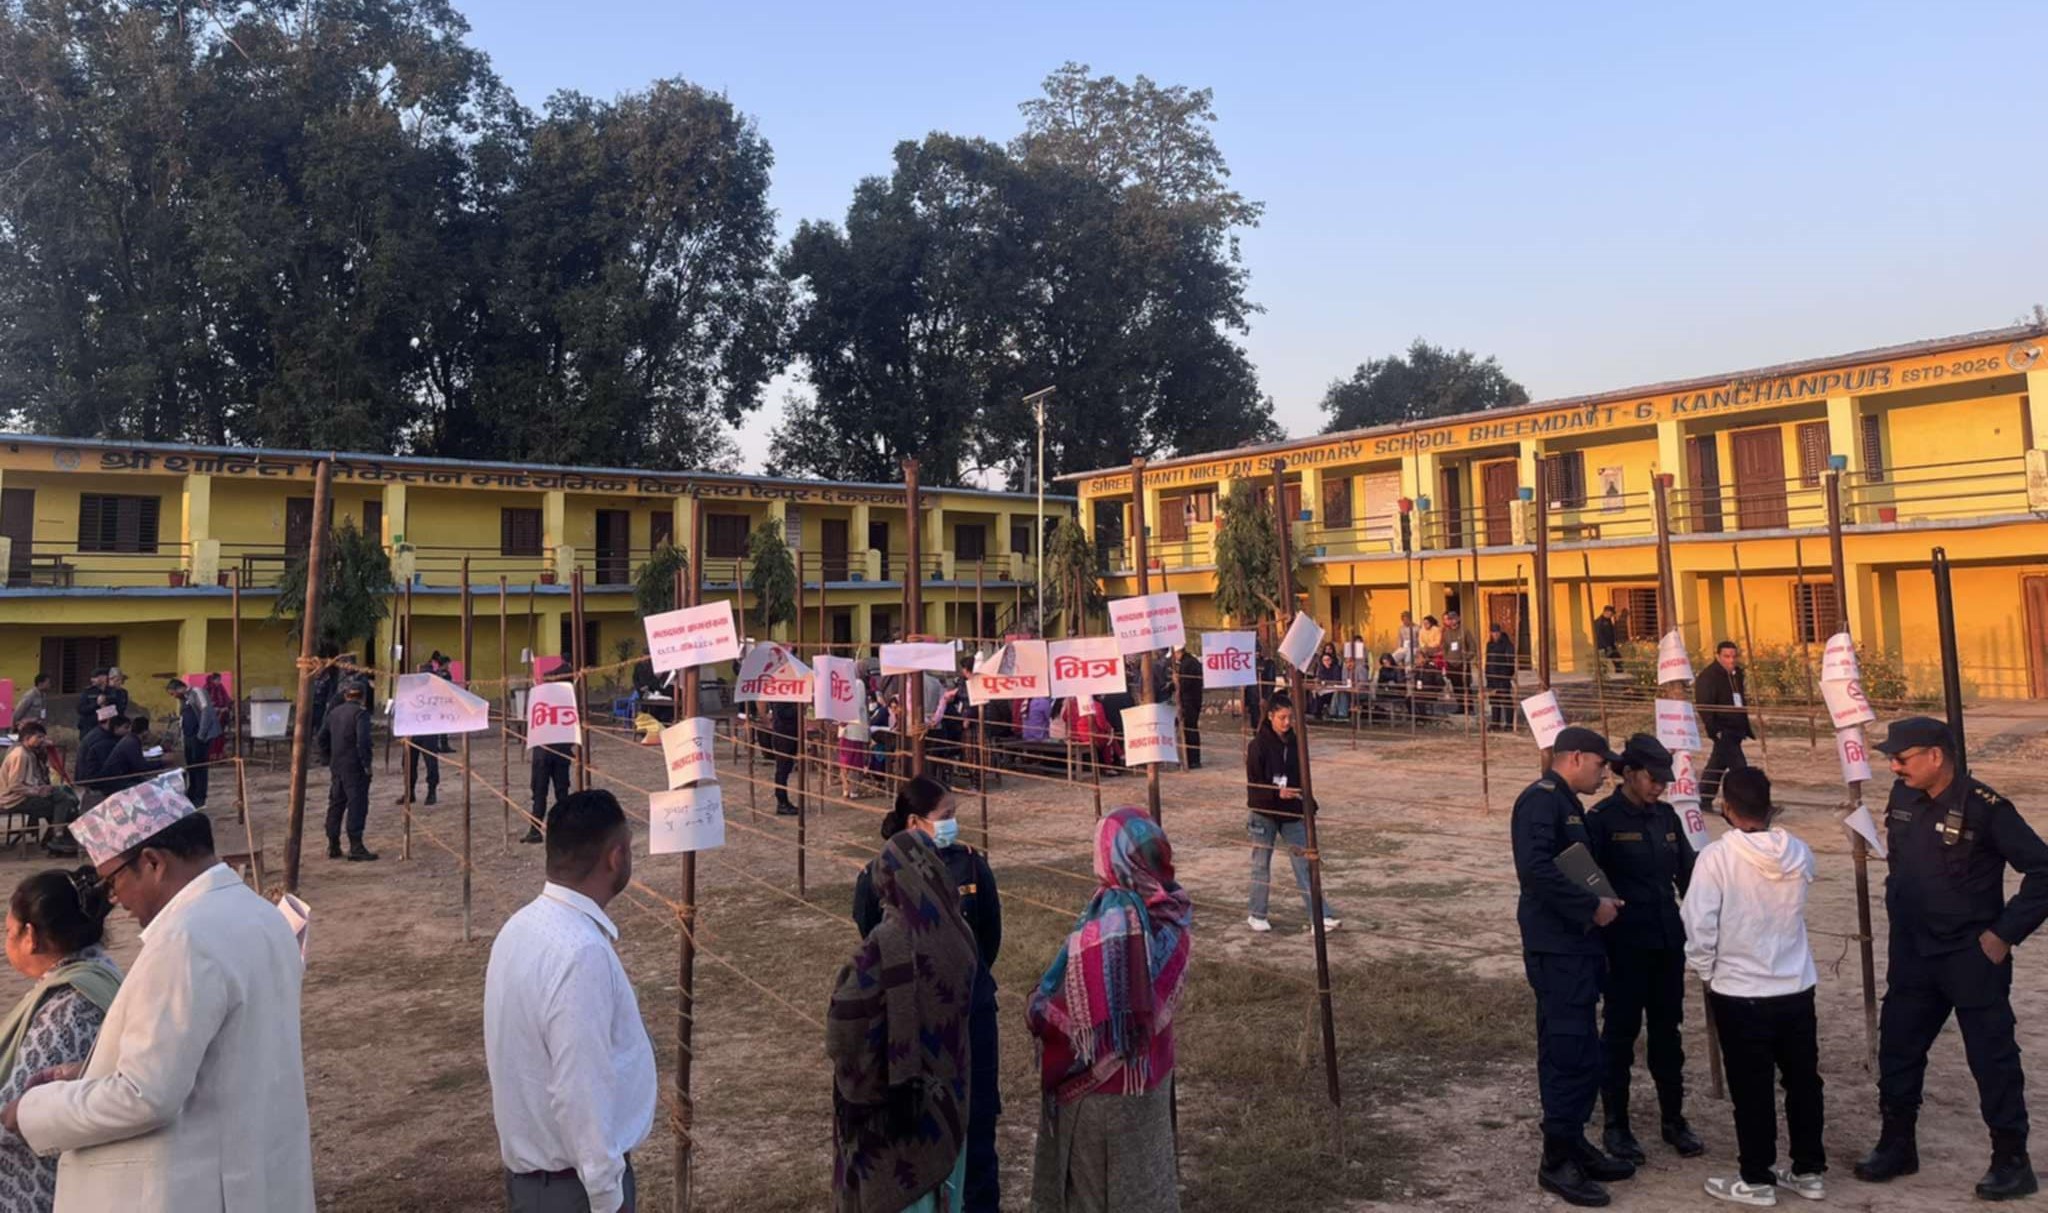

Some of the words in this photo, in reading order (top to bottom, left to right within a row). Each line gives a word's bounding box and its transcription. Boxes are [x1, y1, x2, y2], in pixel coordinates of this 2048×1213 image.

[1143, 467, 1185, 487] HANTI
[1375, 430, 1460, 455] SCHOOL
[1671, 364, 1893, 414] KANCHANPUR
[1901, 356, 2000, 383] ESTD-2026
[100, 451, 157, 471] श्री
[1055, 656, 1118, 681] भित्र
[1206, 646, 1253, 671] बाहिर
[741, 673, 806, 695] महिला
[1843, 740, 1867, 764] भि
[1685, 808, 1706, 835] भि
